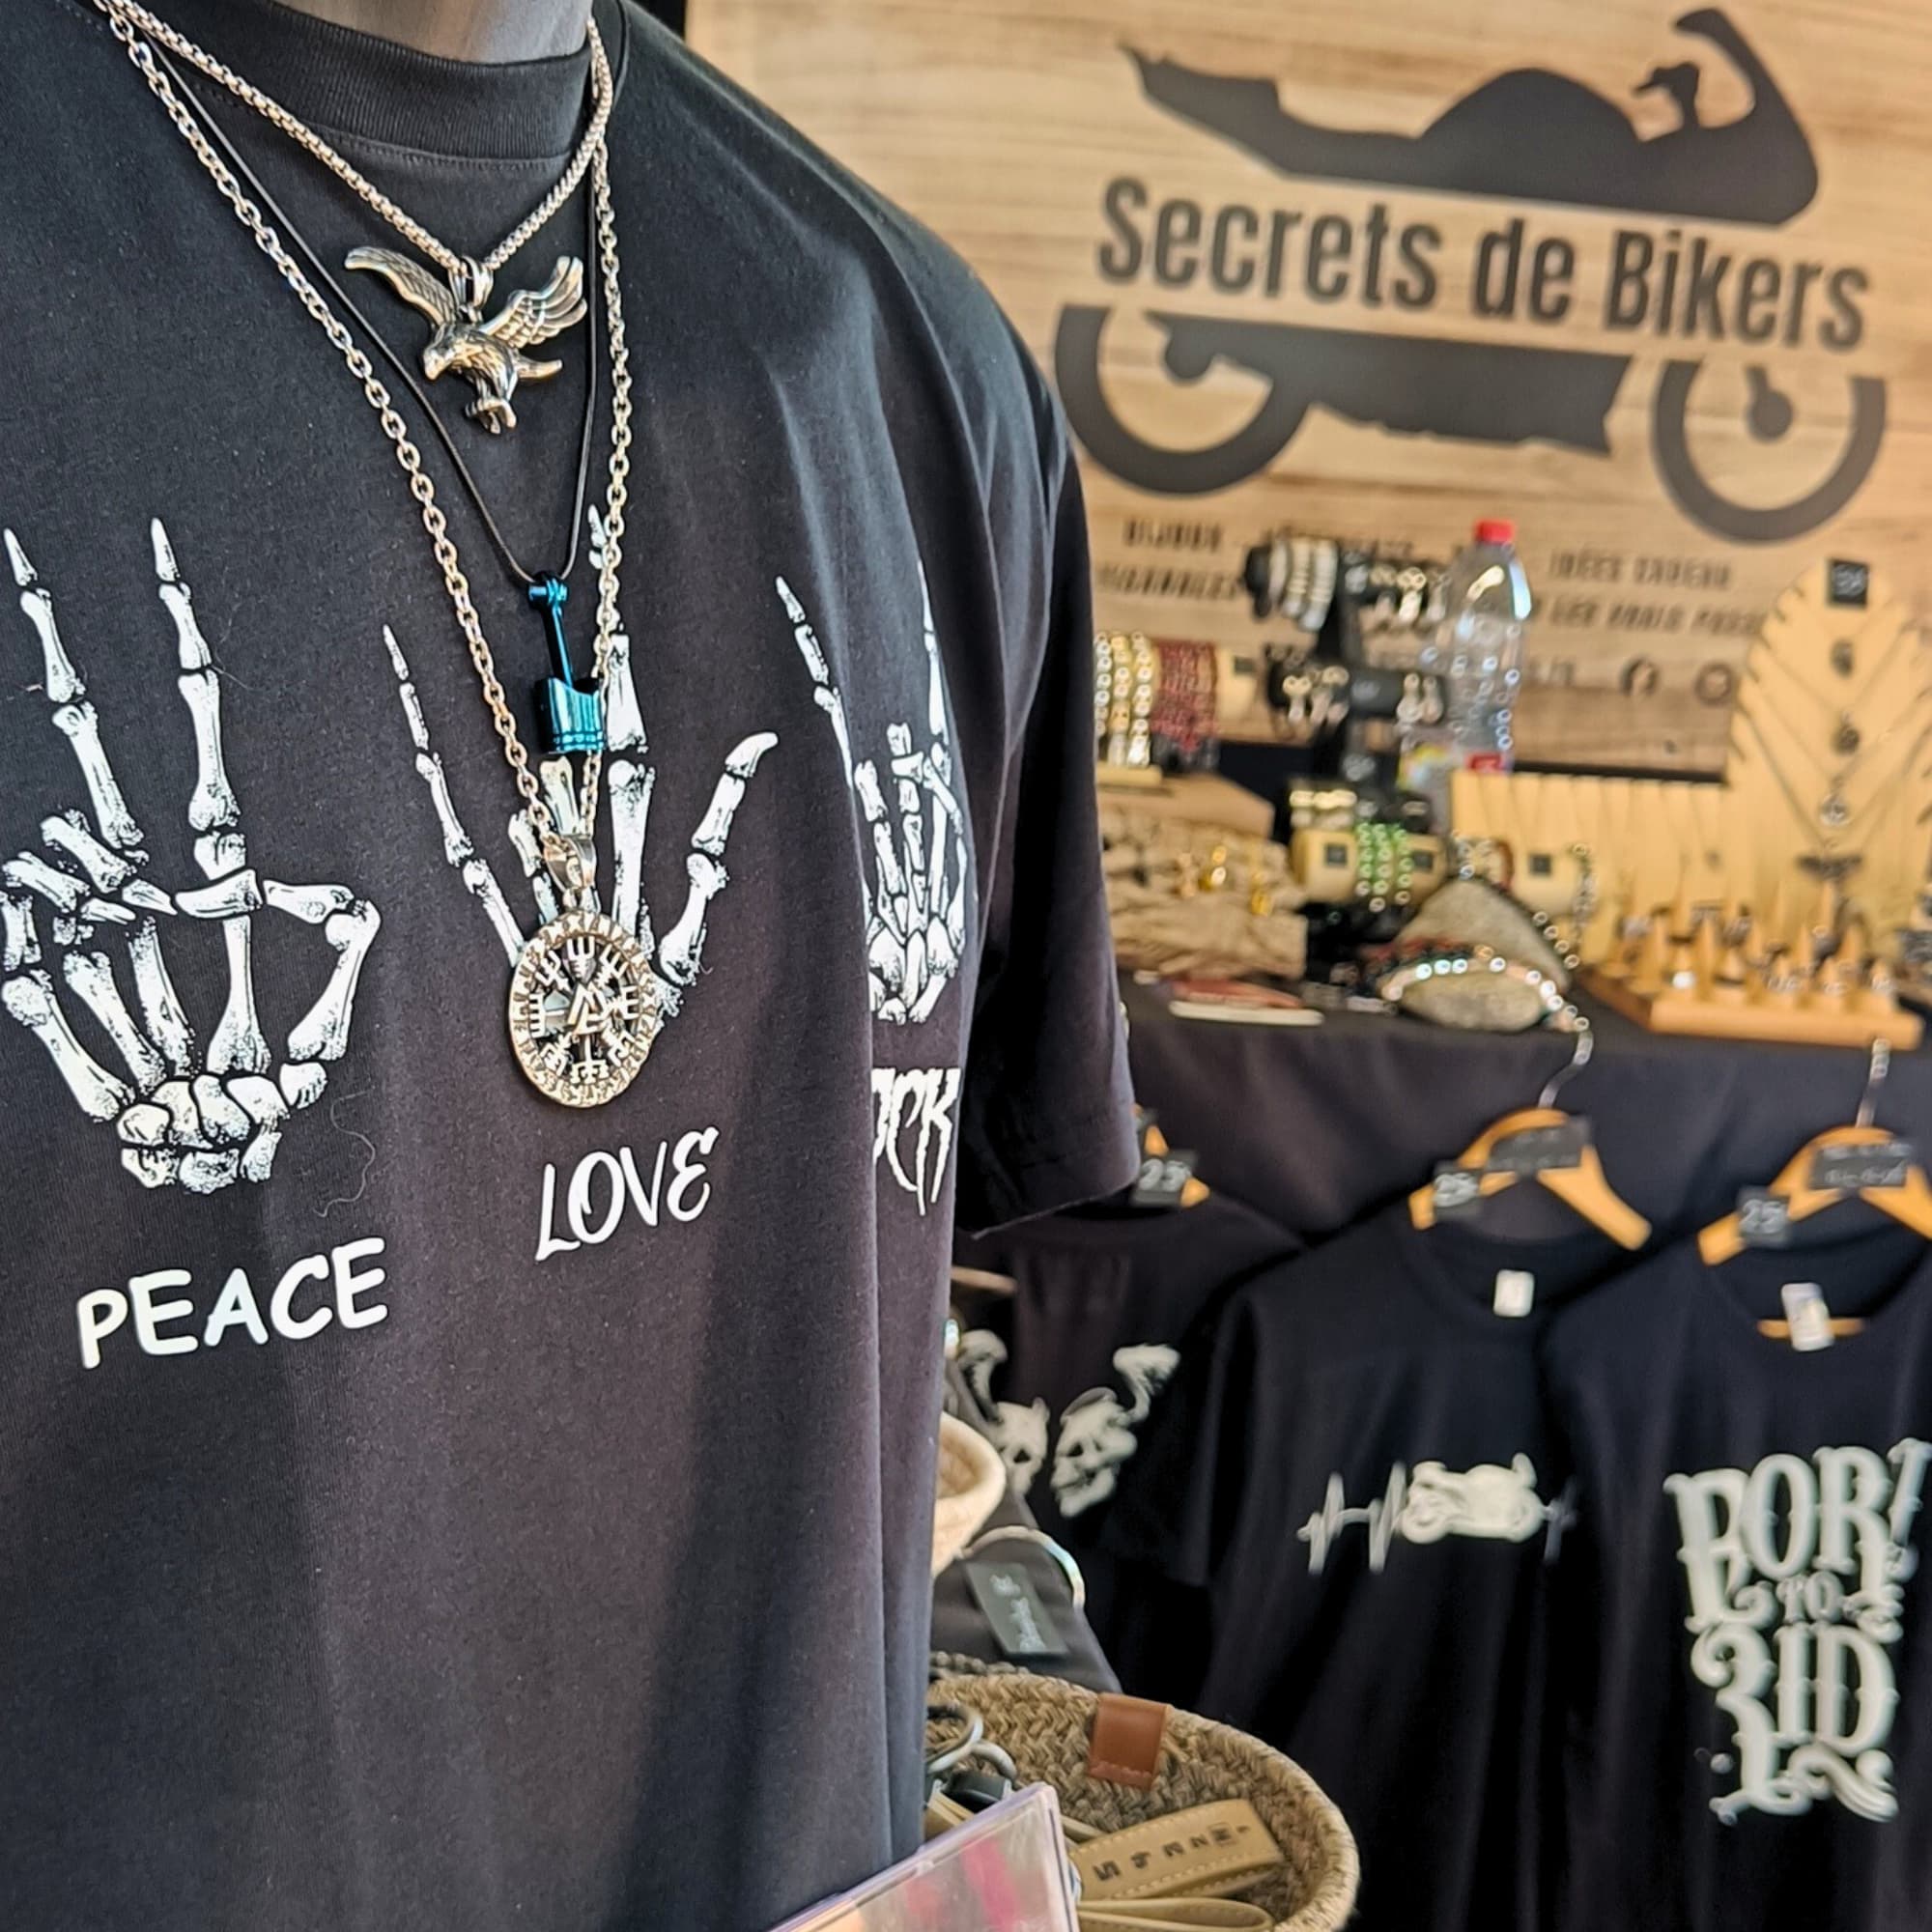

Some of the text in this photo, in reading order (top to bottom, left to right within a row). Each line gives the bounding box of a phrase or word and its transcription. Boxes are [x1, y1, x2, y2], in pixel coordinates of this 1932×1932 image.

[1097, 176, 1872, 354] Secrets de Bikers
[536, 1126, 720, 1262] LOVE
[77, 1237, 388, 1369] PEACE
